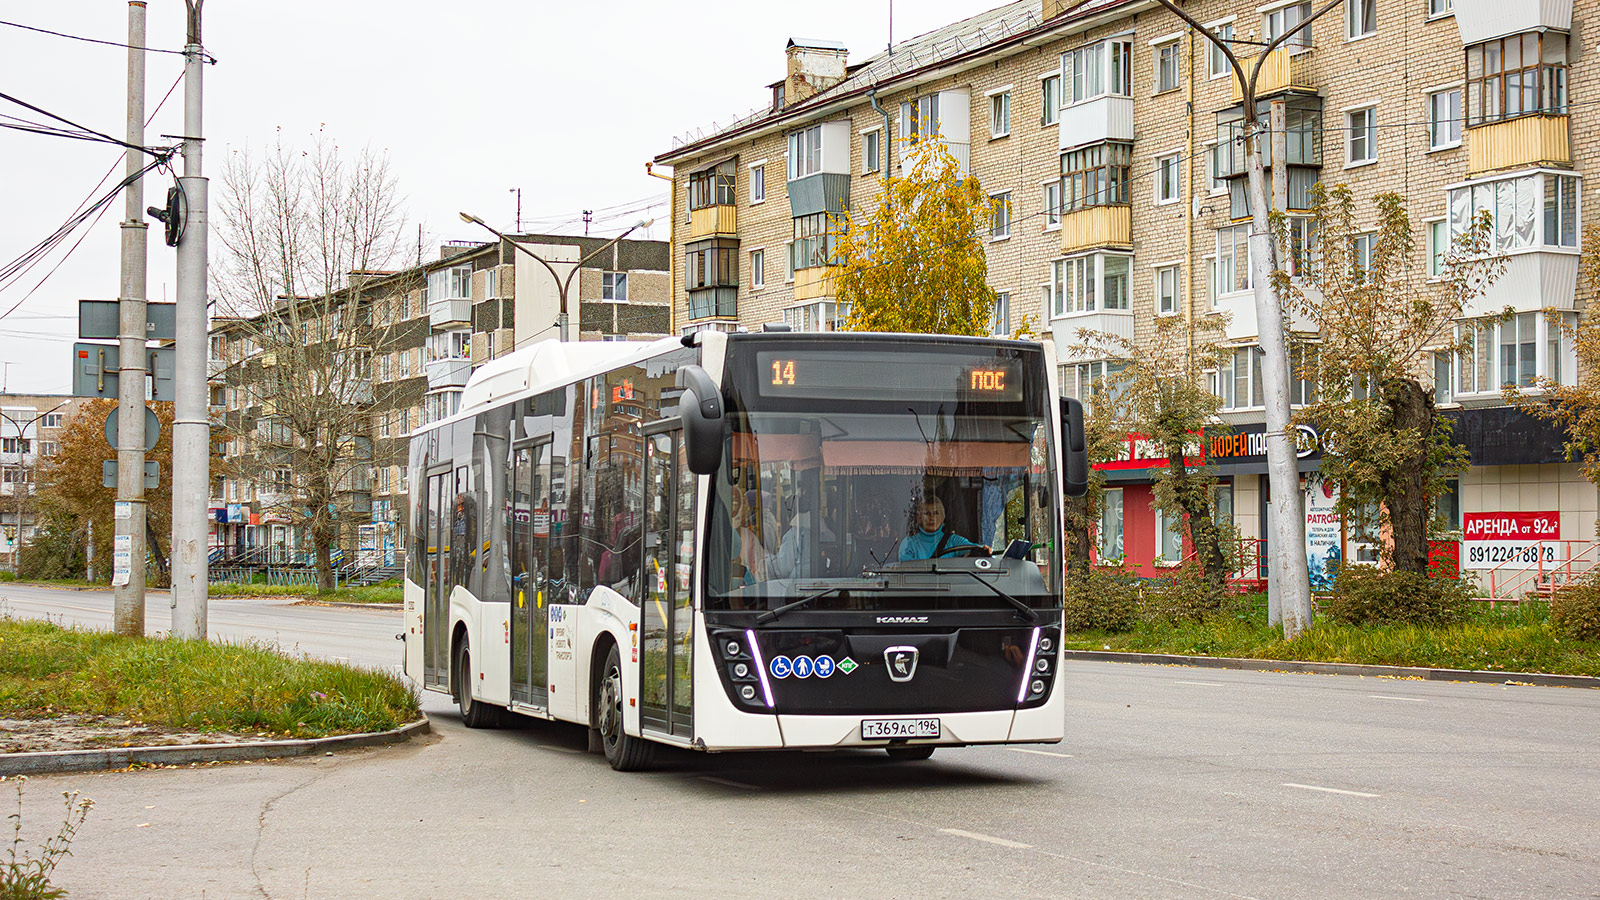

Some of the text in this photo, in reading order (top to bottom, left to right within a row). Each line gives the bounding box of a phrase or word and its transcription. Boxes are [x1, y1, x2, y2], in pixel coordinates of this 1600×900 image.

[771, 360, 796, 385] 14
[1466, 519, 1519, 536] АРЕНДА
[1521, 526, 1531, 534] от
[918, 721, 937, 730] 196
